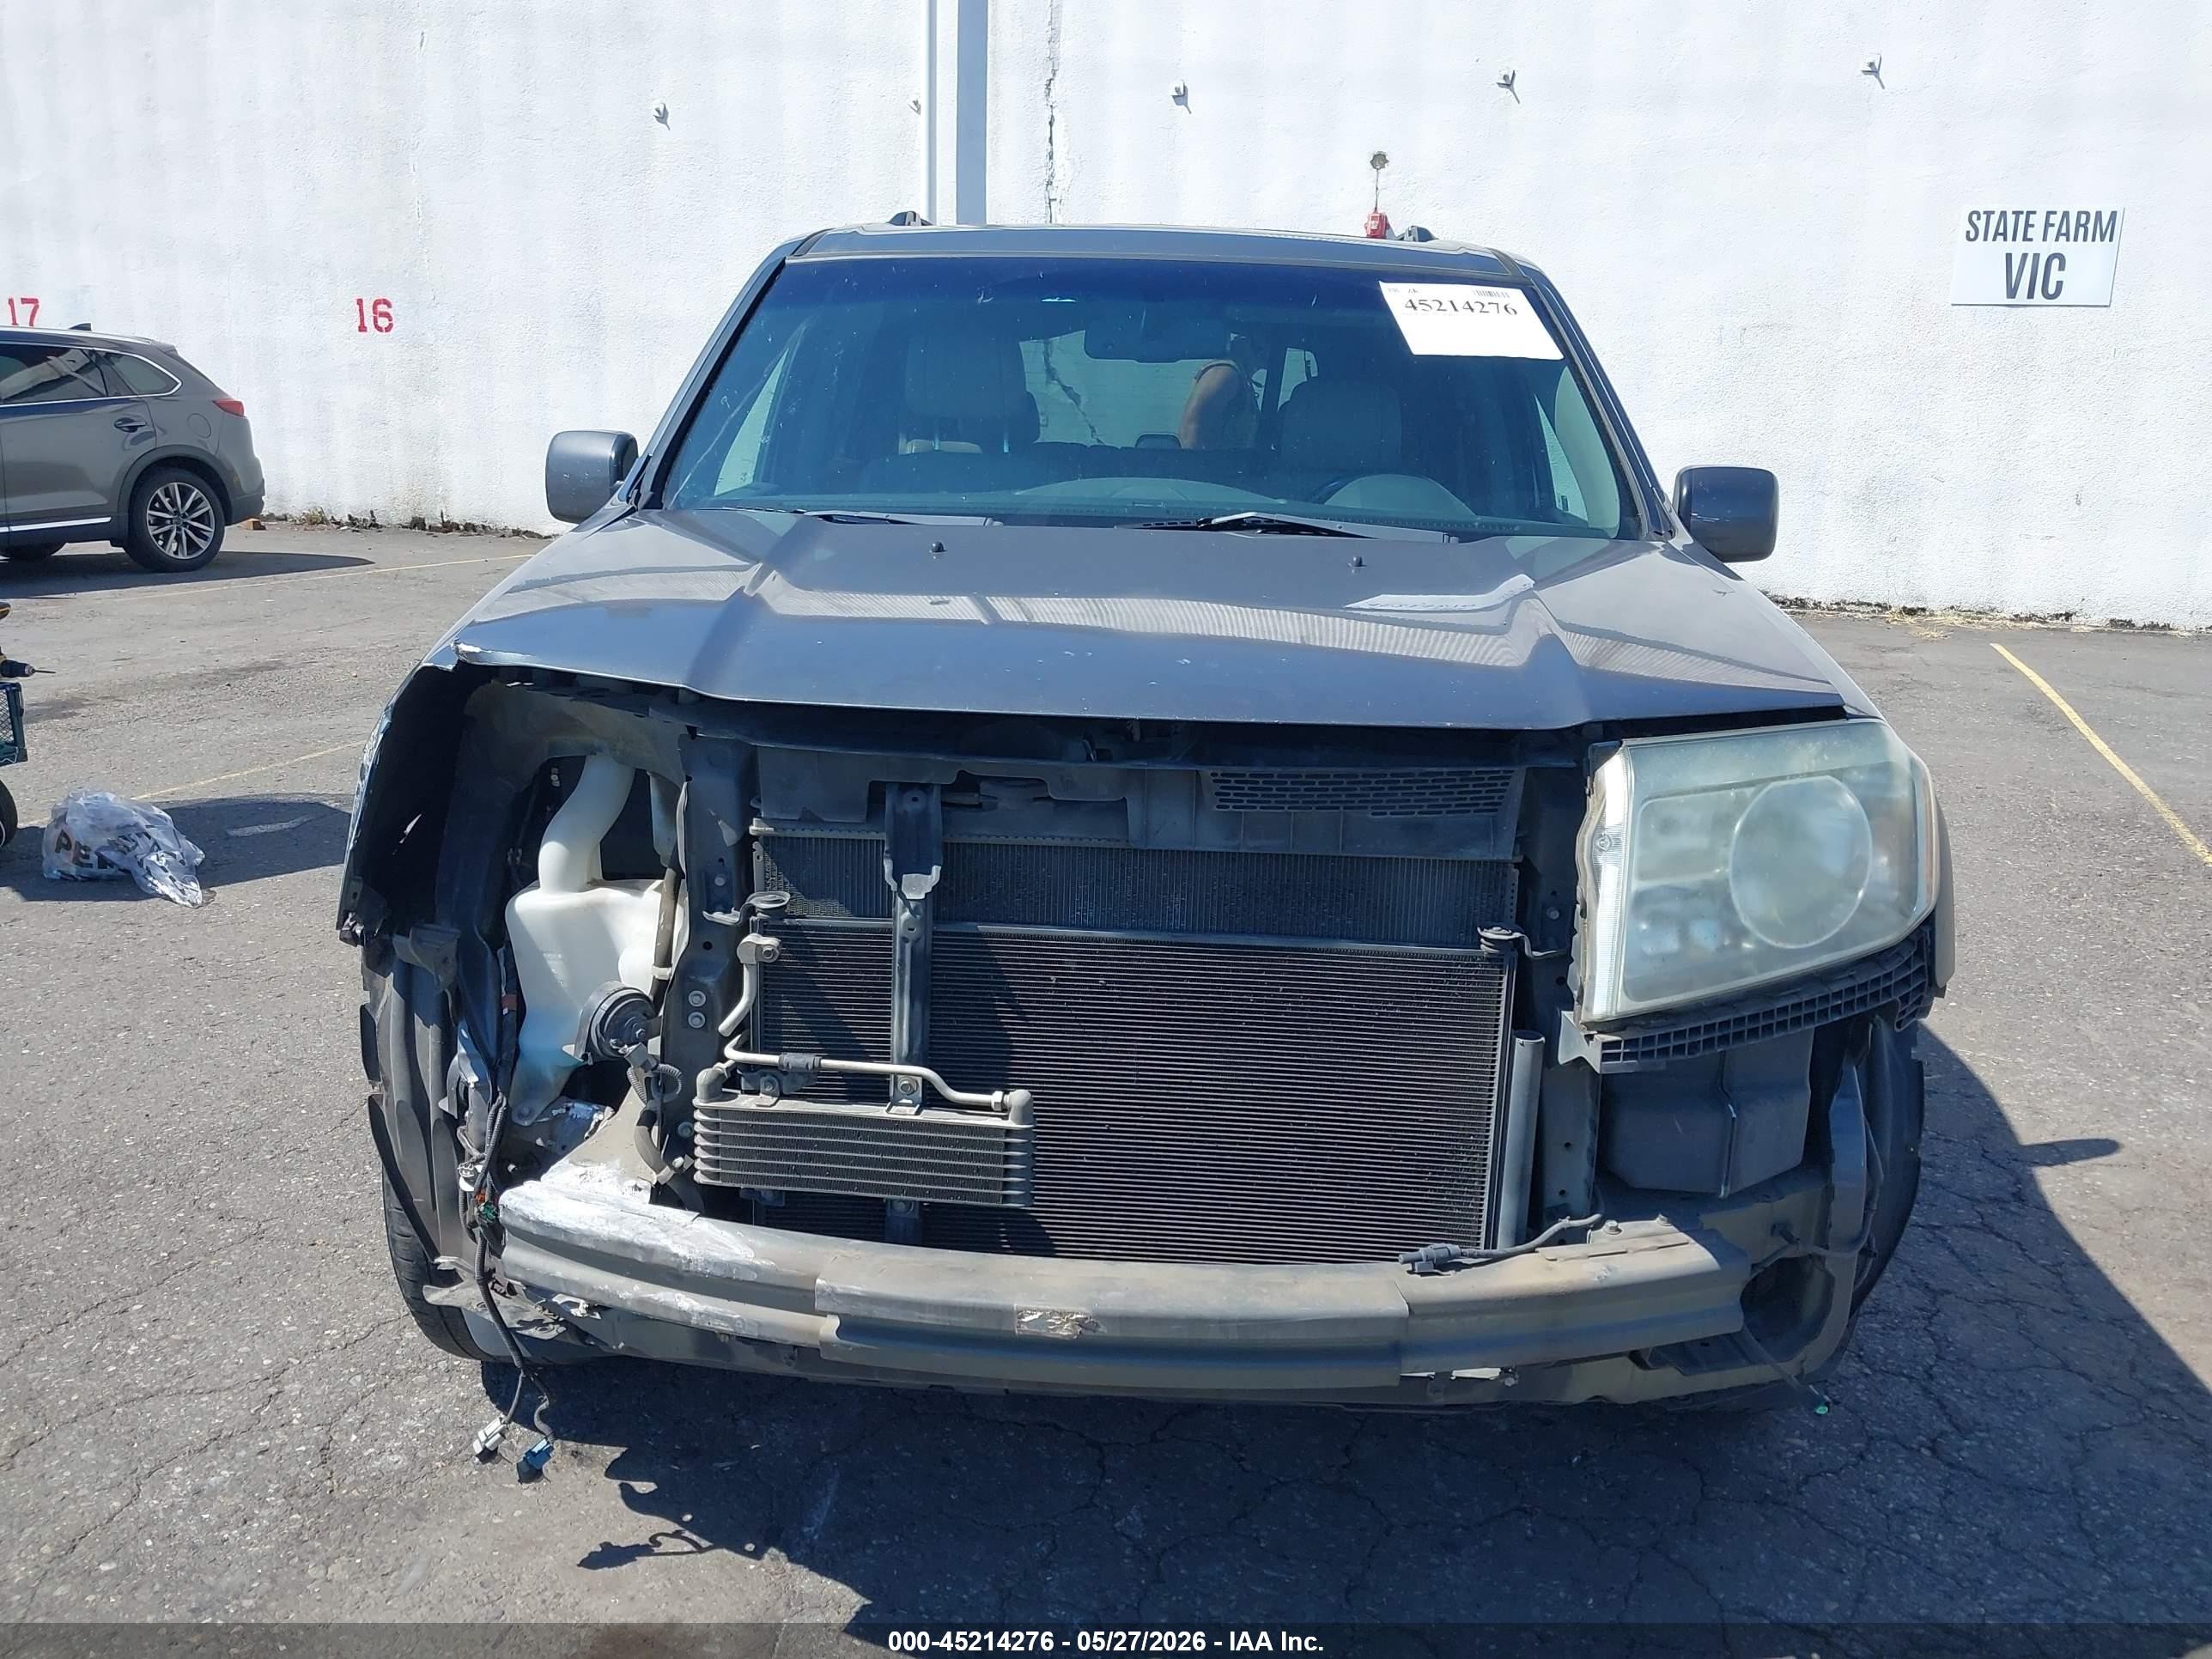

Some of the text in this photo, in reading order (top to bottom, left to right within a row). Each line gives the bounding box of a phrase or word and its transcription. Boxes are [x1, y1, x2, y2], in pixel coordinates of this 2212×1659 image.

[1965, 210, 2118, 242] STATE FARM
[2005, 252, 2068, 301] VIC
[7, 296, 40, 327] 17
[355, 297, 395, 334] 16
[1404, 298, 1518, 315] 45214276
